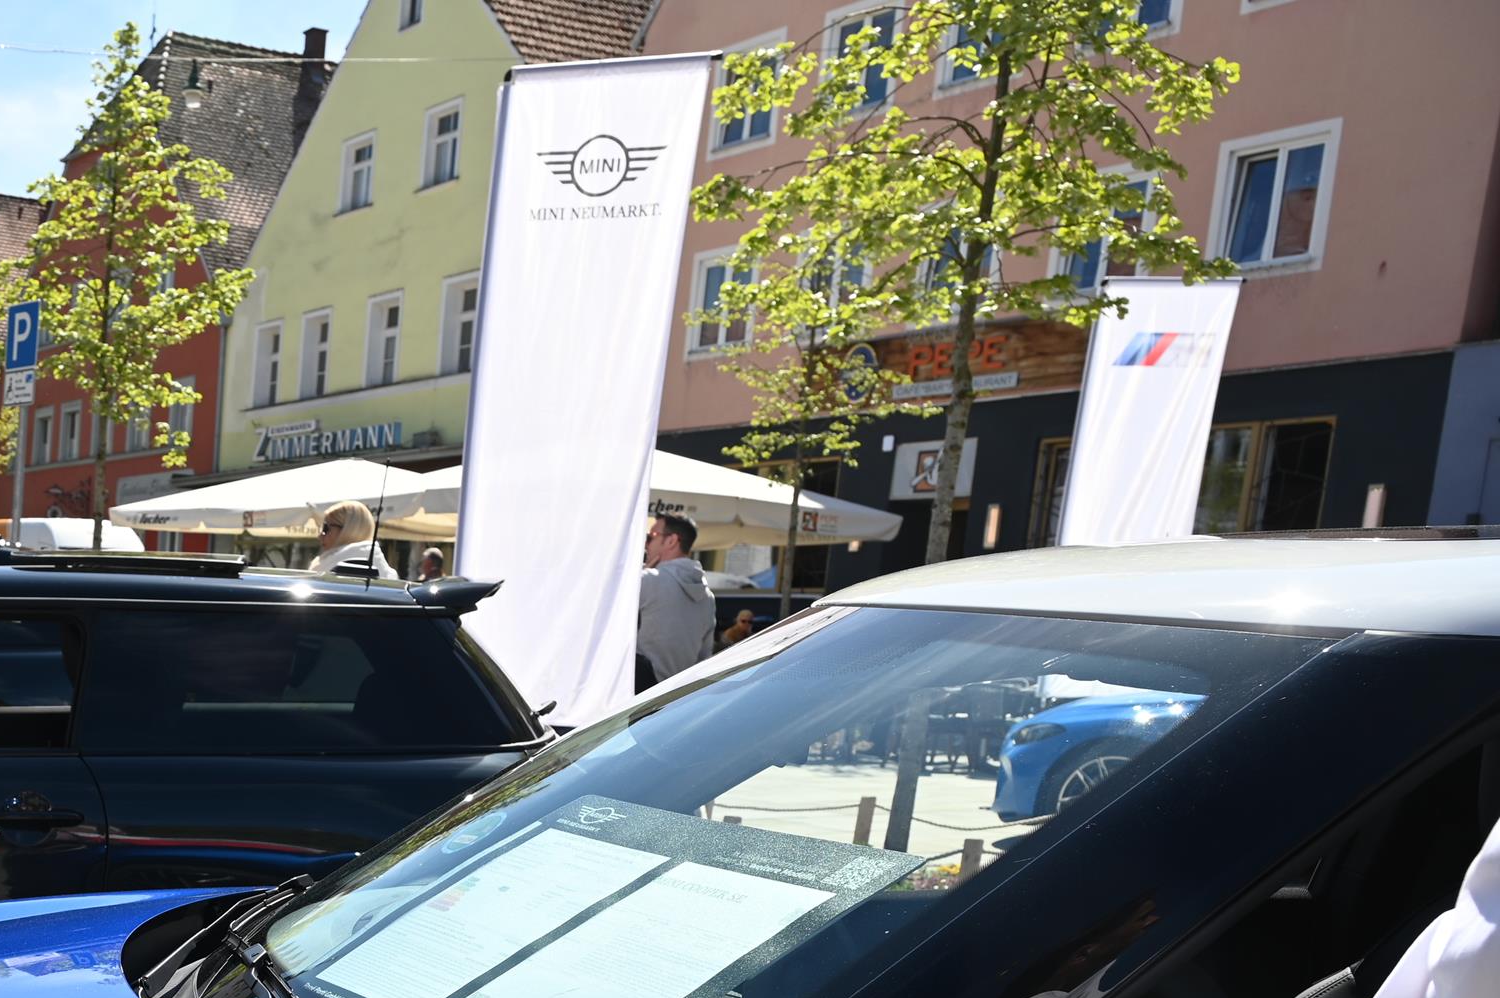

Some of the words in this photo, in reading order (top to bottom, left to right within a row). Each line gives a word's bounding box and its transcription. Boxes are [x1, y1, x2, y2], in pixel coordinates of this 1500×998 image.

[579, 158, 621, 174] MINI
[530, 207, 565, 221] MINI
[571, 202, 662, 219] NEUMARKT.
[12, 312, 32, 361] P
[253, 422, 396, 461] ZIMMERMANN
